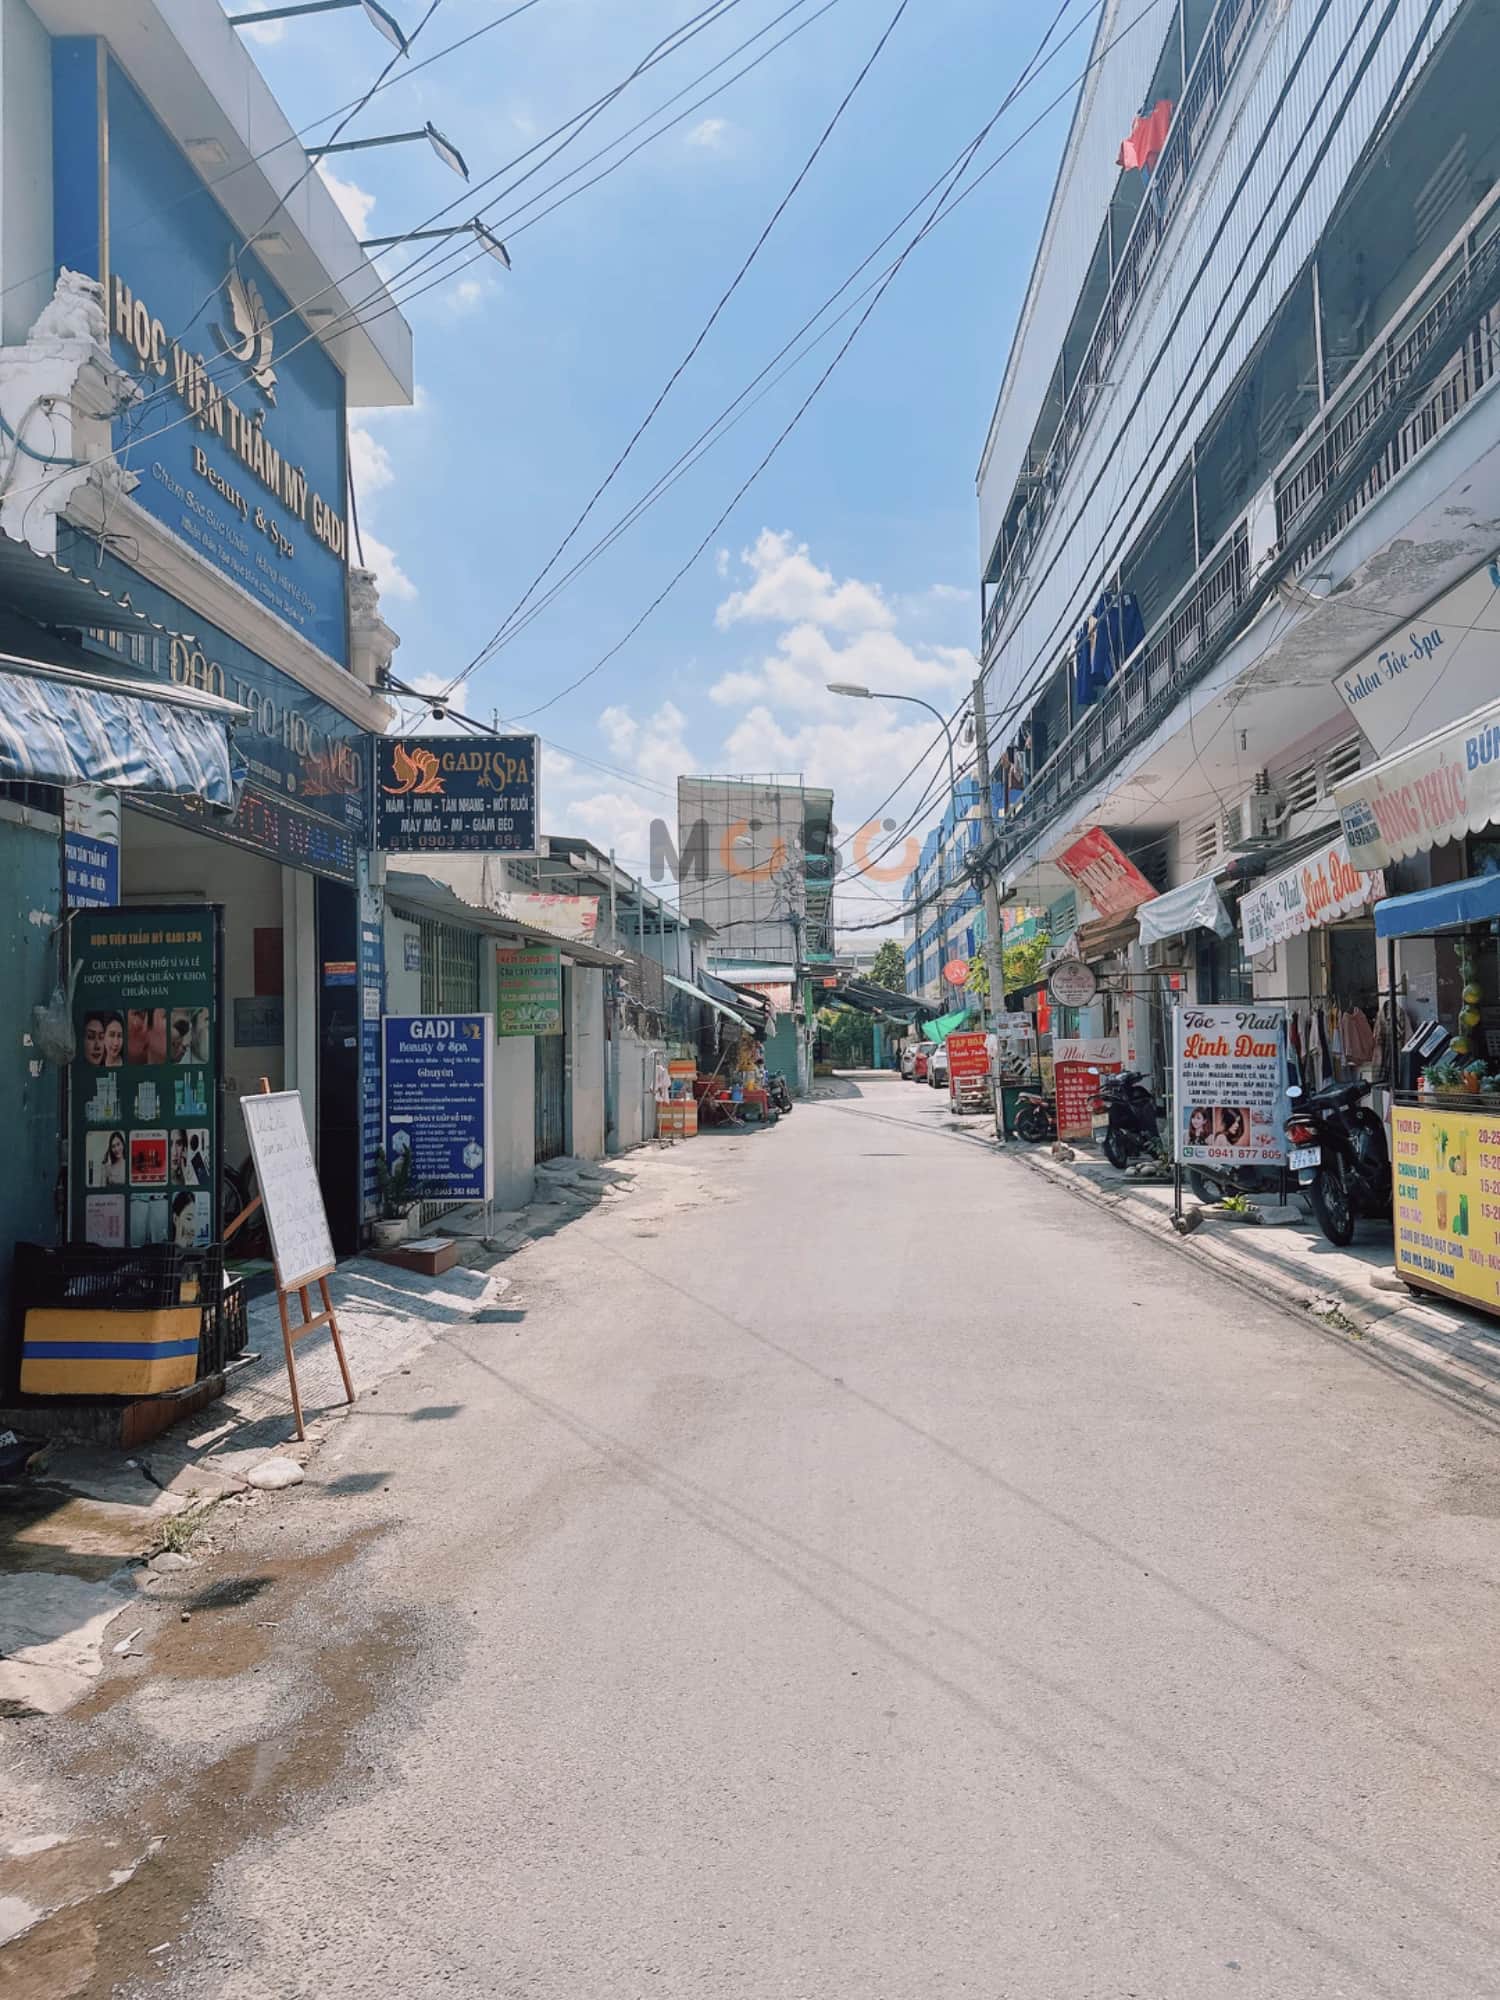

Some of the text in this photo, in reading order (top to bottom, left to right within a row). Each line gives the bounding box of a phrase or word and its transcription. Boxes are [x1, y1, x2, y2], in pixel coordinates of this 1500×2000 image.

[116, 274, 167, 377] HỌC
[227, 407, 280, 496] THẨM
[284, 461, 308, 521] MỸ
[313, 492, 345, 561] GADI
[196, 447, 294, 559] Beauty & Spa
[1344, 671, 1382, 705] Salon
[442, 752, 492, 771] GADI
[410, 1020, 456, 1039] GADI
[1235, 1011, 1281, 1031] Nail
[399, 1041, 468, 1056] Beauty & Spa
[1184, 1033, 1230, 1060] Linh
[1208, 1147, 1234, 1158] 0941
[1238, 1149, 1258, 1159] 877
